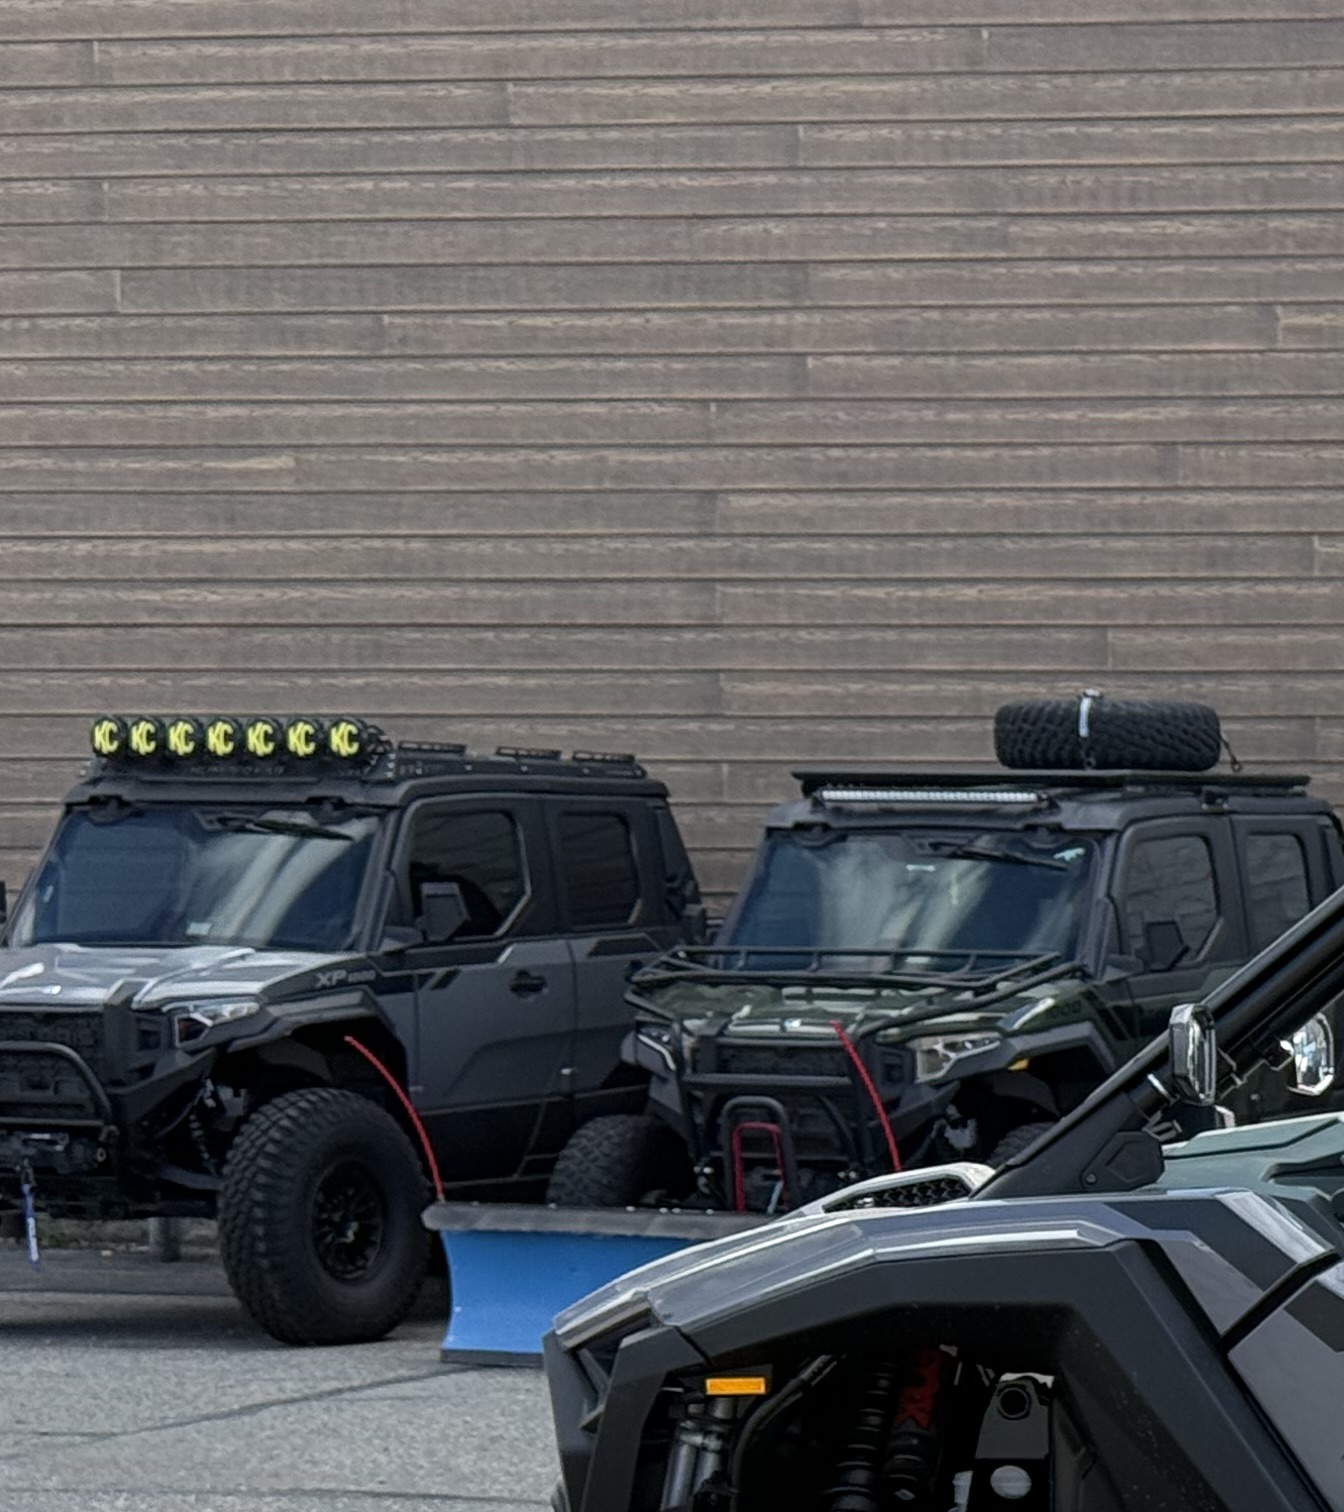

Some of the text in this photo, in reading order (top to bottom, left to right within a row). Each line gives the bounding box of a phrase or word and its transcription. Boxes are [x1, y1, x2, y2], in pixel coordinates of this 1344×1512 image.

[94, 720, 119, 754] KC
[131, 721, 157, 755] KC
[169, 721, 195, 756] KC
[208, 721, 234, 756] KC
[247, 721, 275, 756] KC
[288, 721, 316, 756] KC
[331, 721, 359, 757] KC
